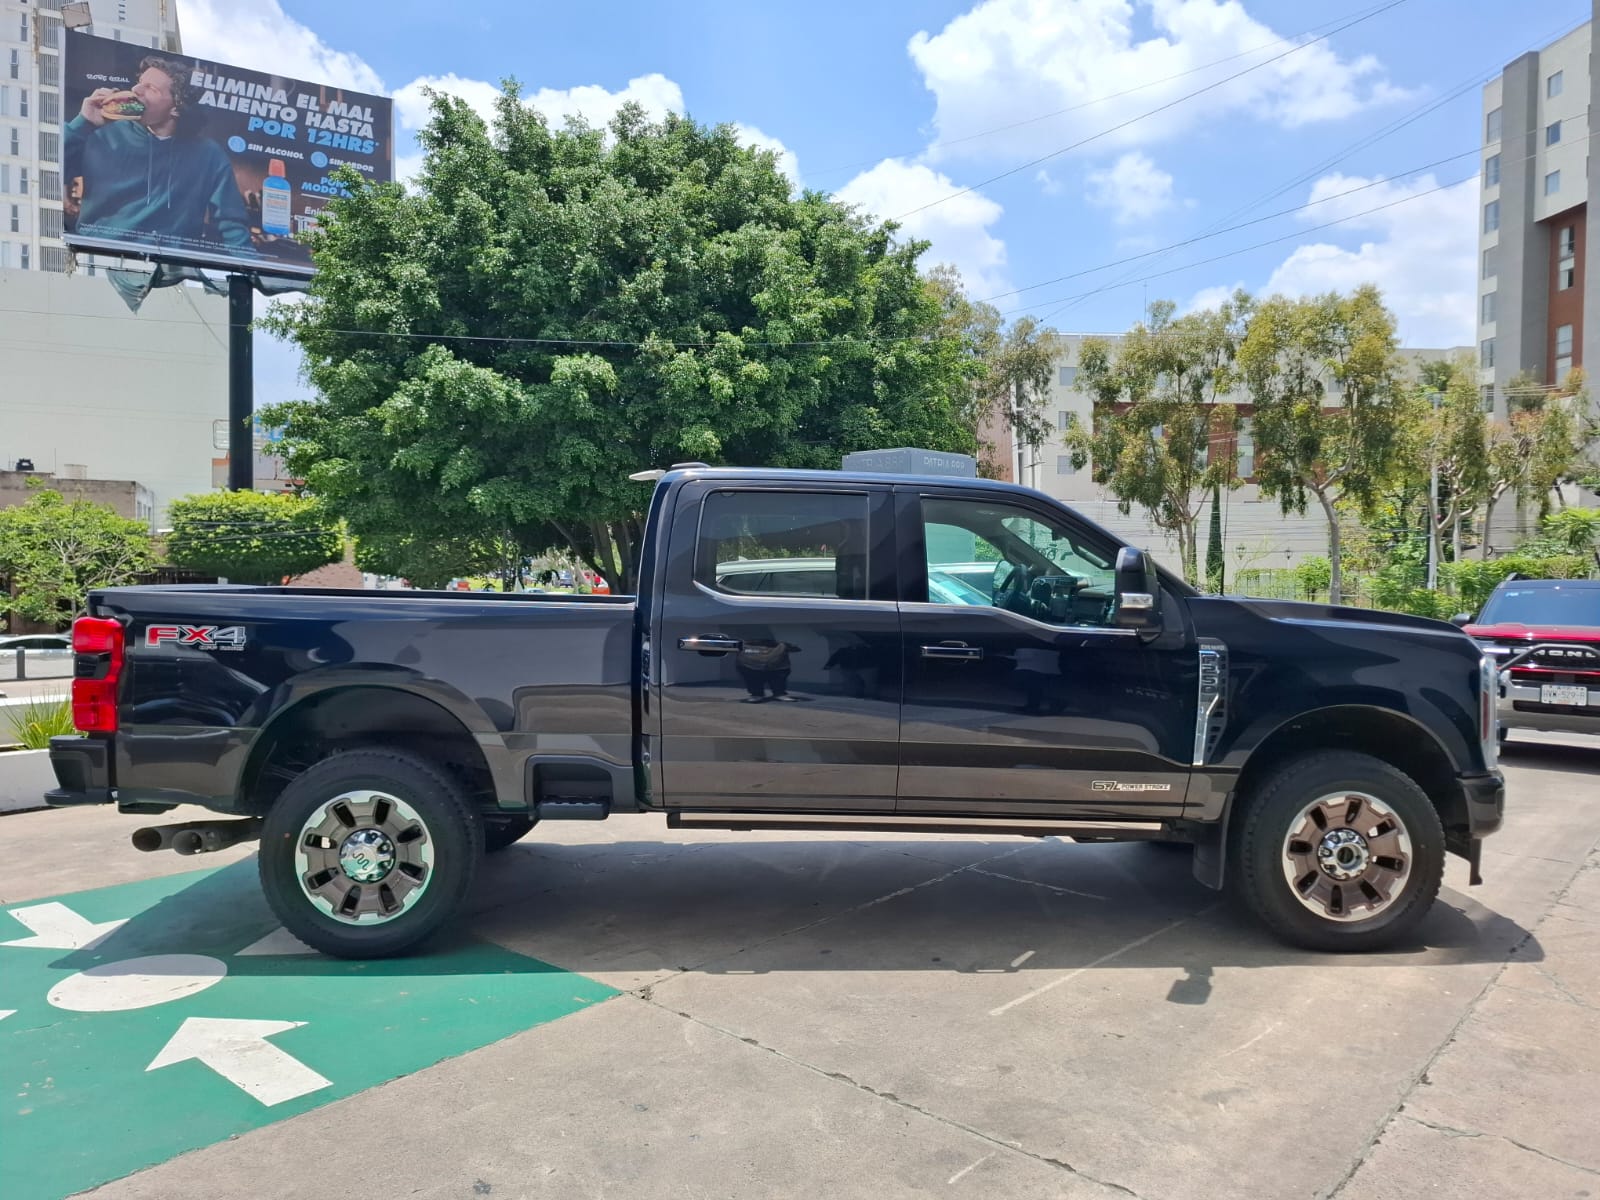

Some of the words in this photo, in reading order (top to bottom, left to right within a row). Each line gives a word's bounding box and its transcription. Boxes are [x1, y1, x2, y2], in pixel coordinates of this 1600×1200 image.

[190, 71, 288, 105] ELIMINA
[296, 93, 320, 111] EL
[327, 100, 374, 123] MAL
[198, 90, 298, 123] ALIENTO
[305, 111, 374, 139] HASTA
[248, 116, 296, 140] POR
[247, 143, 263, 152] SIN
[264, 146, 304, 160] ALCOHOL
[302, 181, 337, 195] MODO
[145, 624, 246, 648] FX4
